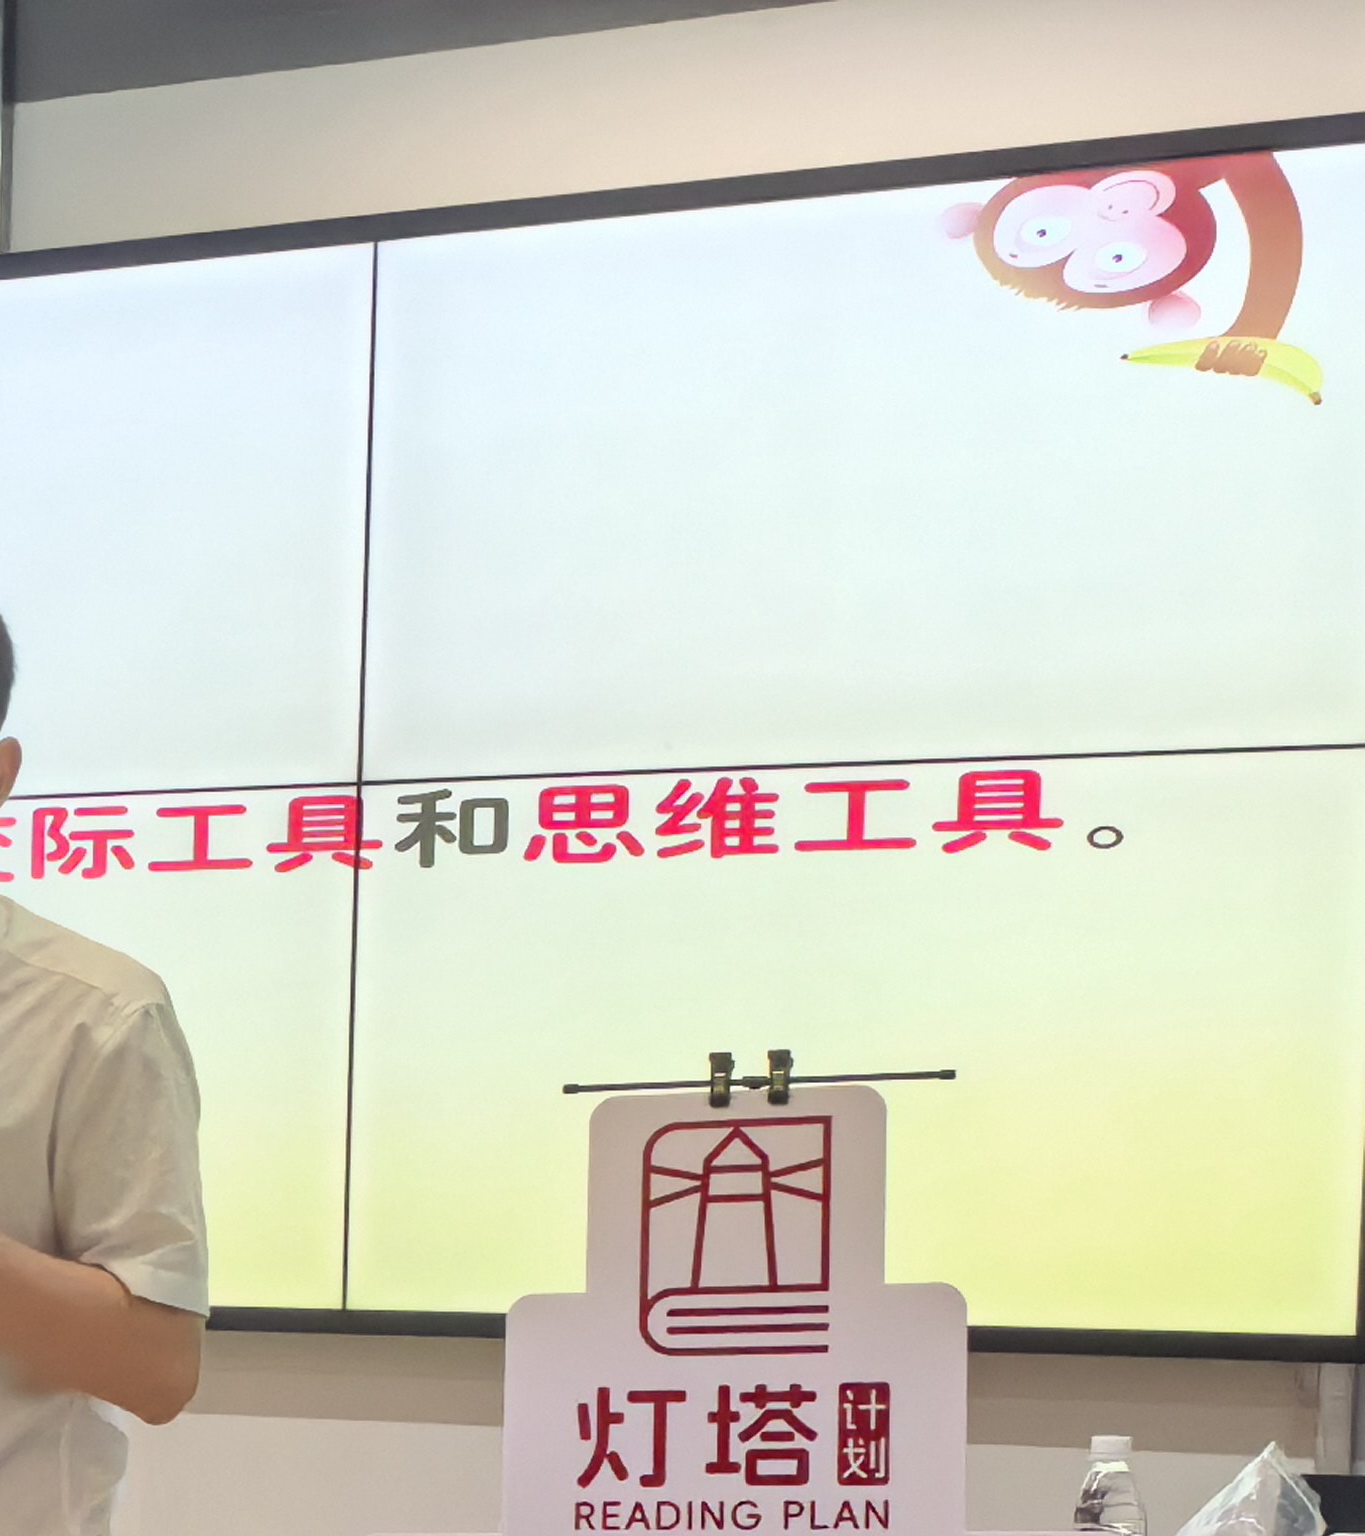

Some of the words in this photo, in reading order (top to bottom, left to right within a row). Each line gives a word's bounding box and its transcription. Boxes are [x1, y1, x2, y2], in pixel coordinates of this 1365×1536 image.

[576, 1383, 819, 1489] 灯塔
[842, 1389, 887, 1479] 计划
[574, 1499, 763, 1531] READING
[782, 1499, 890, 1531] PLAN
